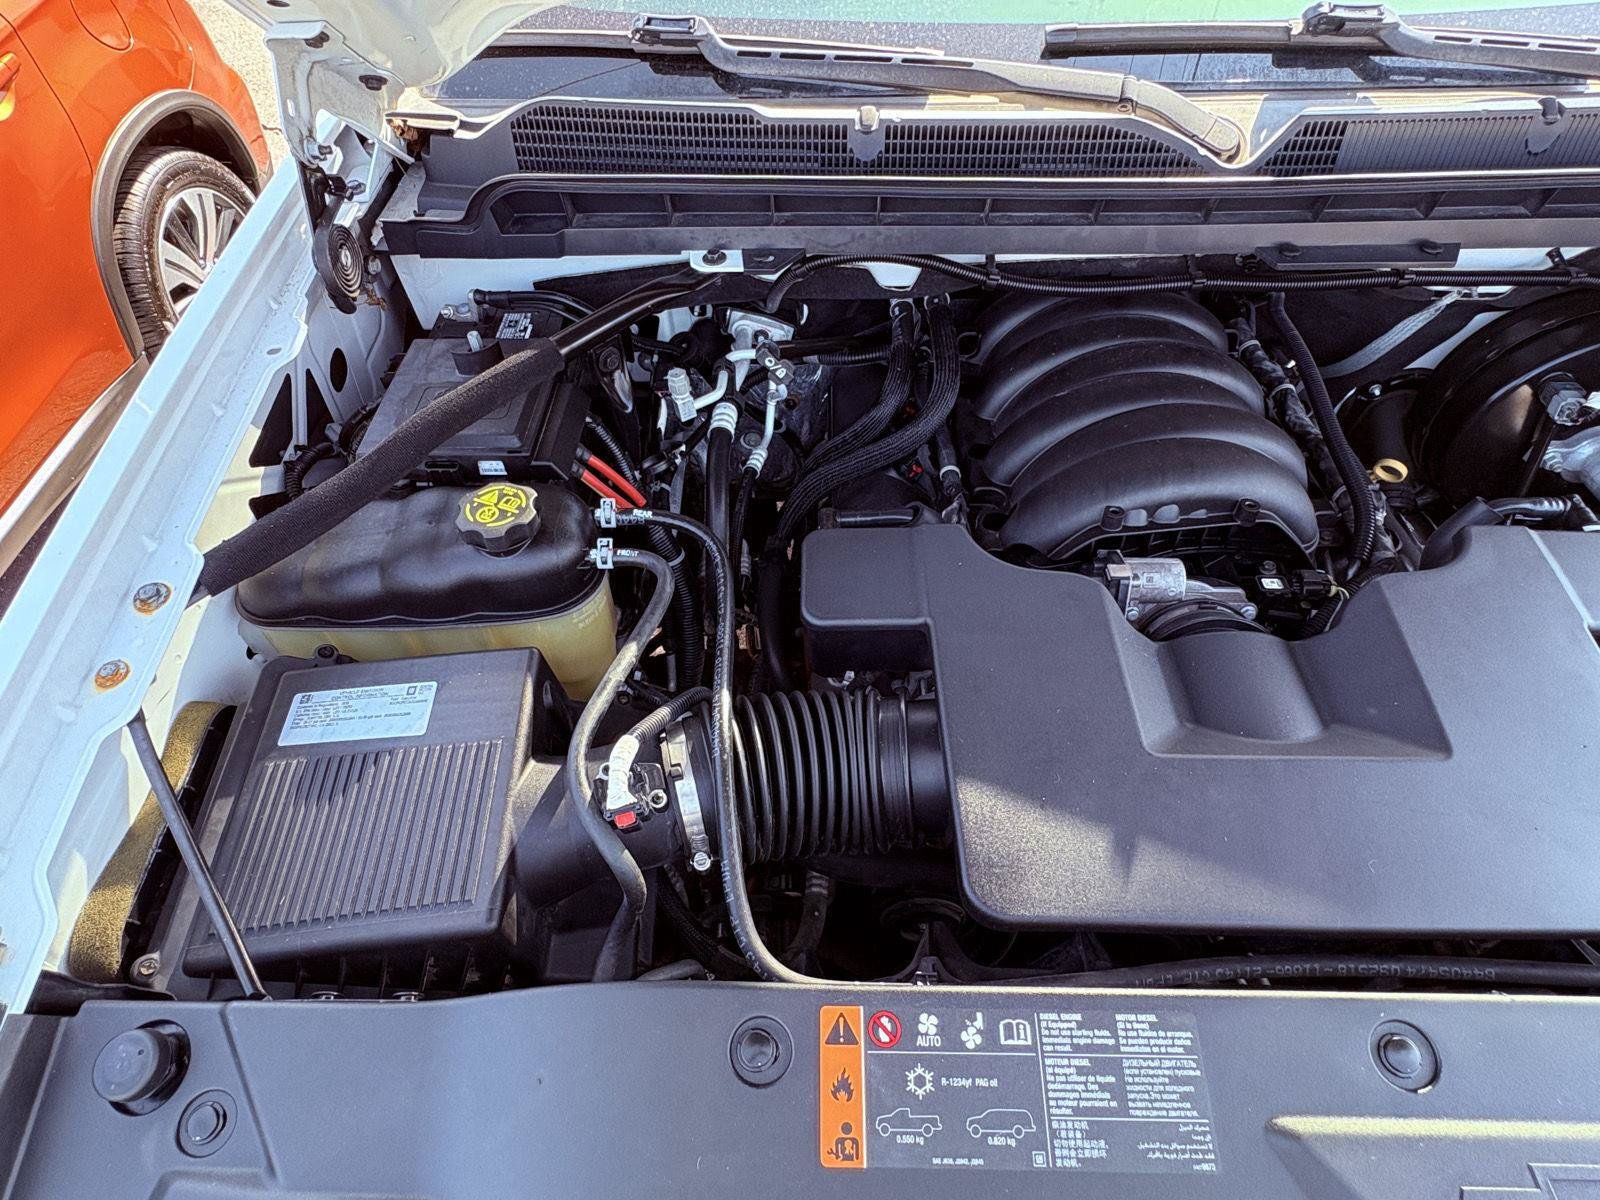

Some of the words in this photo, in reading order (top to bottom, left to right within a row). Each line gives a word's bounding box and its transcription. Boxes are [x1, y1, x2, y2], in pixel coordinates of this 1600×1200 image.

[633, 509, 653, 518] REAR
[616, 549, 639, 557] FRONT
[917, 1035, 941, 1047] AUTO
[1072, 1037, 1092, 1045] engine
[941, 1078, 972, 1089] R-1234yf
[975, 1078, 989, 1087] PAG
[896, 1135, 915, 1144] 0.550
[915, 1136, 924, 1146] kg
[1007, 1137, 1016, 1147] kg
